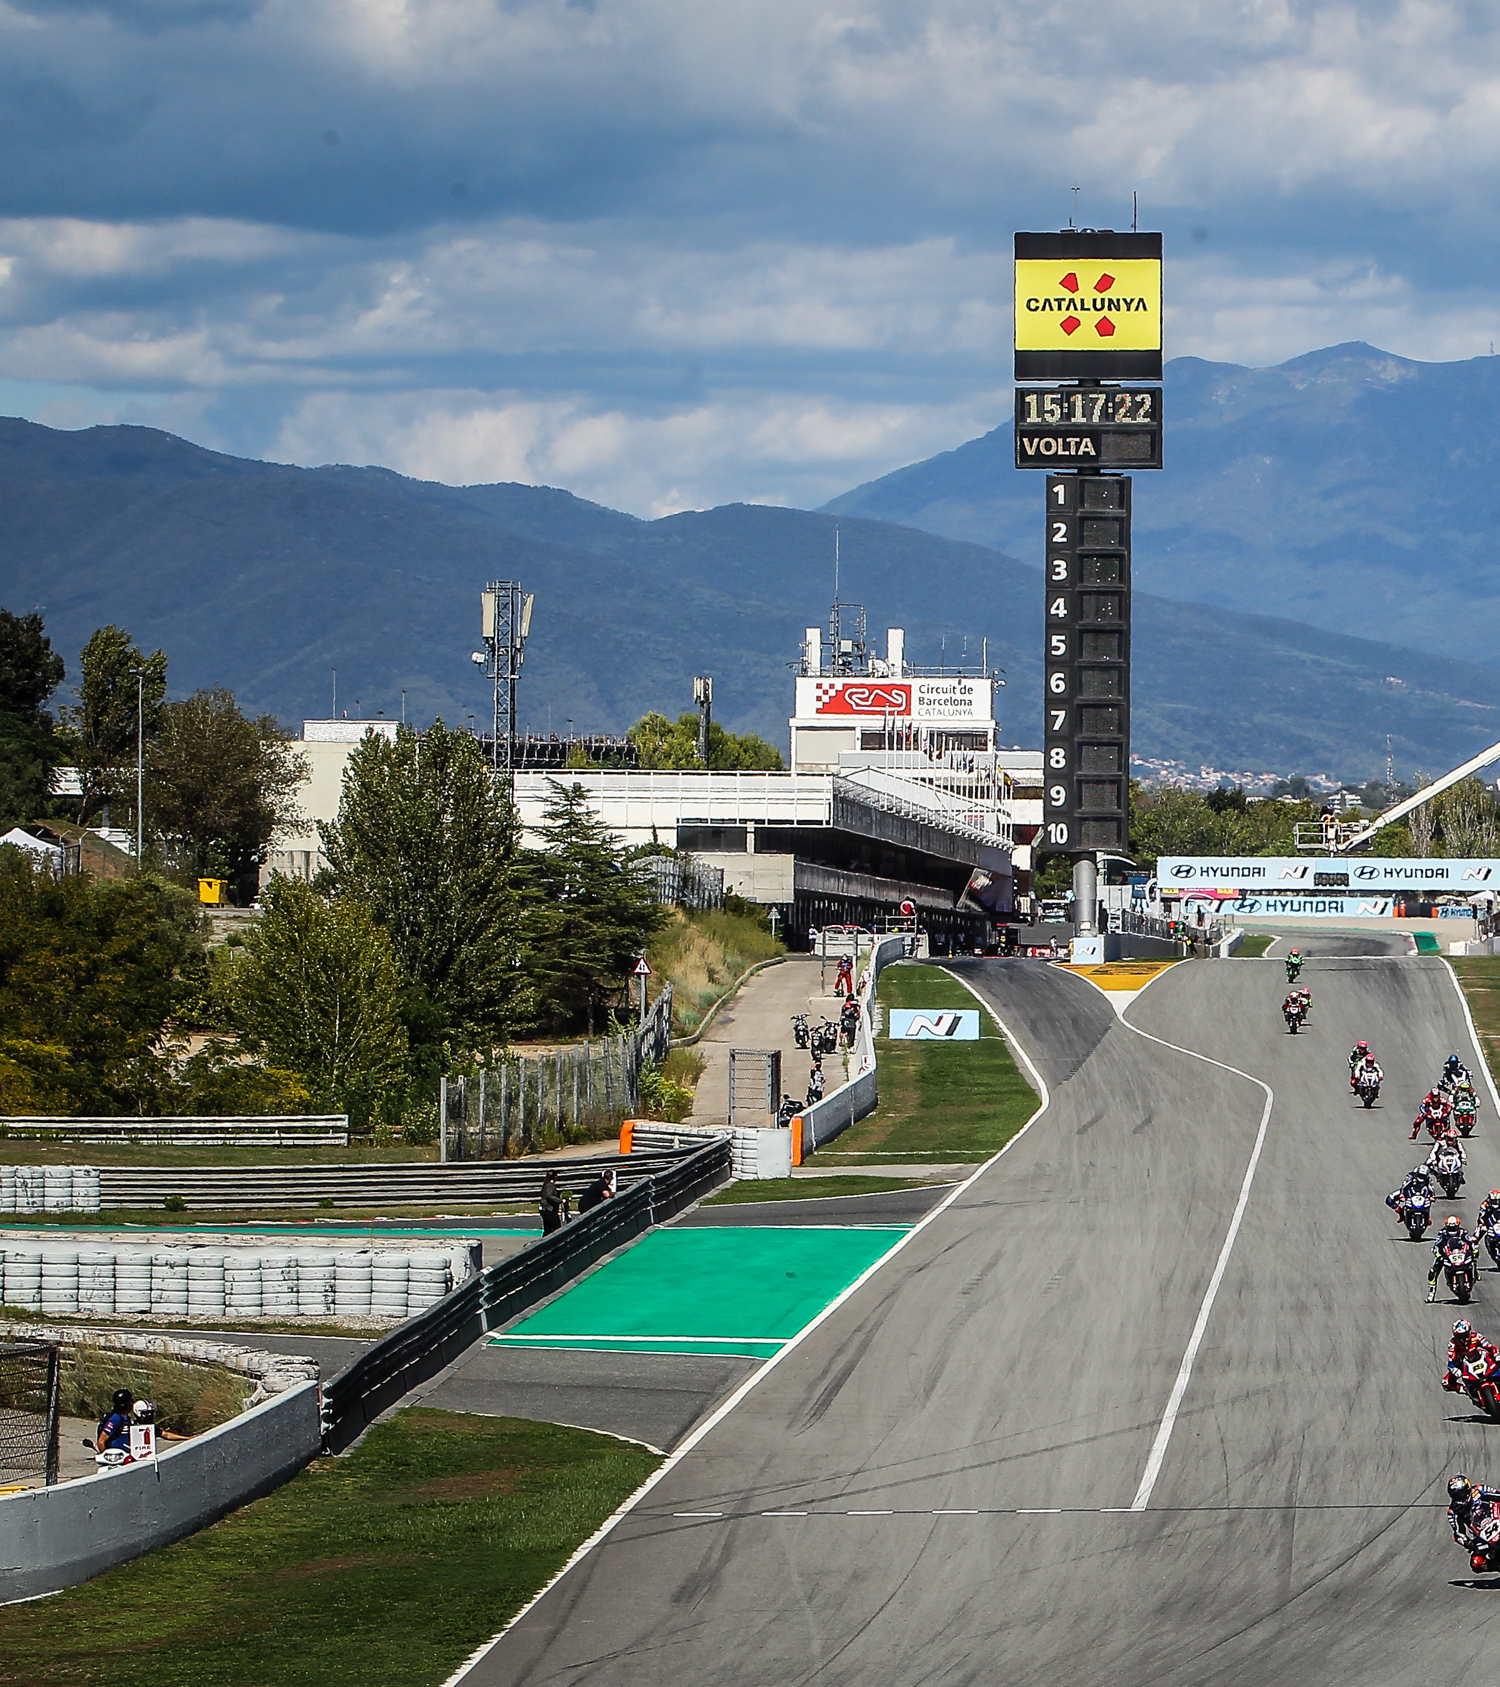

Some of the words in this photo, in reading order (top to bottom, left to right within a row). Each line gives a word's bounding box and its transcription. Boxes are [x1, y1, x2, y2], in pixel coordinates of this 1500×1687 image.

[1026, 298, 1148, 312] CATALUNYA
[1025, 393, 1151, 423] 15:17:22
[1022, 437, 1096, 456] VOLTA
[1052, 485, 1066, 505] 1
[1052, 522, 1068, 543] 2
[1052, 560, 1068, 581] 3
[1050, 598, 1068, 618] 4
[1051, 635, 1067, 656] 5
[919, 684, 957, 695] Circuit
[959, 684, 974, 695] de
[1050, 673, 1066, 694] 6
[919, 696, 973, 706] Barcelona
[918, 708, 974, 717] CATALUNYA
[1050, 710, 1066, 731] 7
[1050, 748, 1066, 769] 8
[1050, 785, 1067, 807] 9
[1047, 823, 1068, 845] 10
[1200, 866, 1266, 878] HYUNDAI
[1383, 867, 1449, 879] HYUNDAI
[1266, 900, 1344, 914] HYUNDAI
[1484, 1522, 1499, 1540] 54
